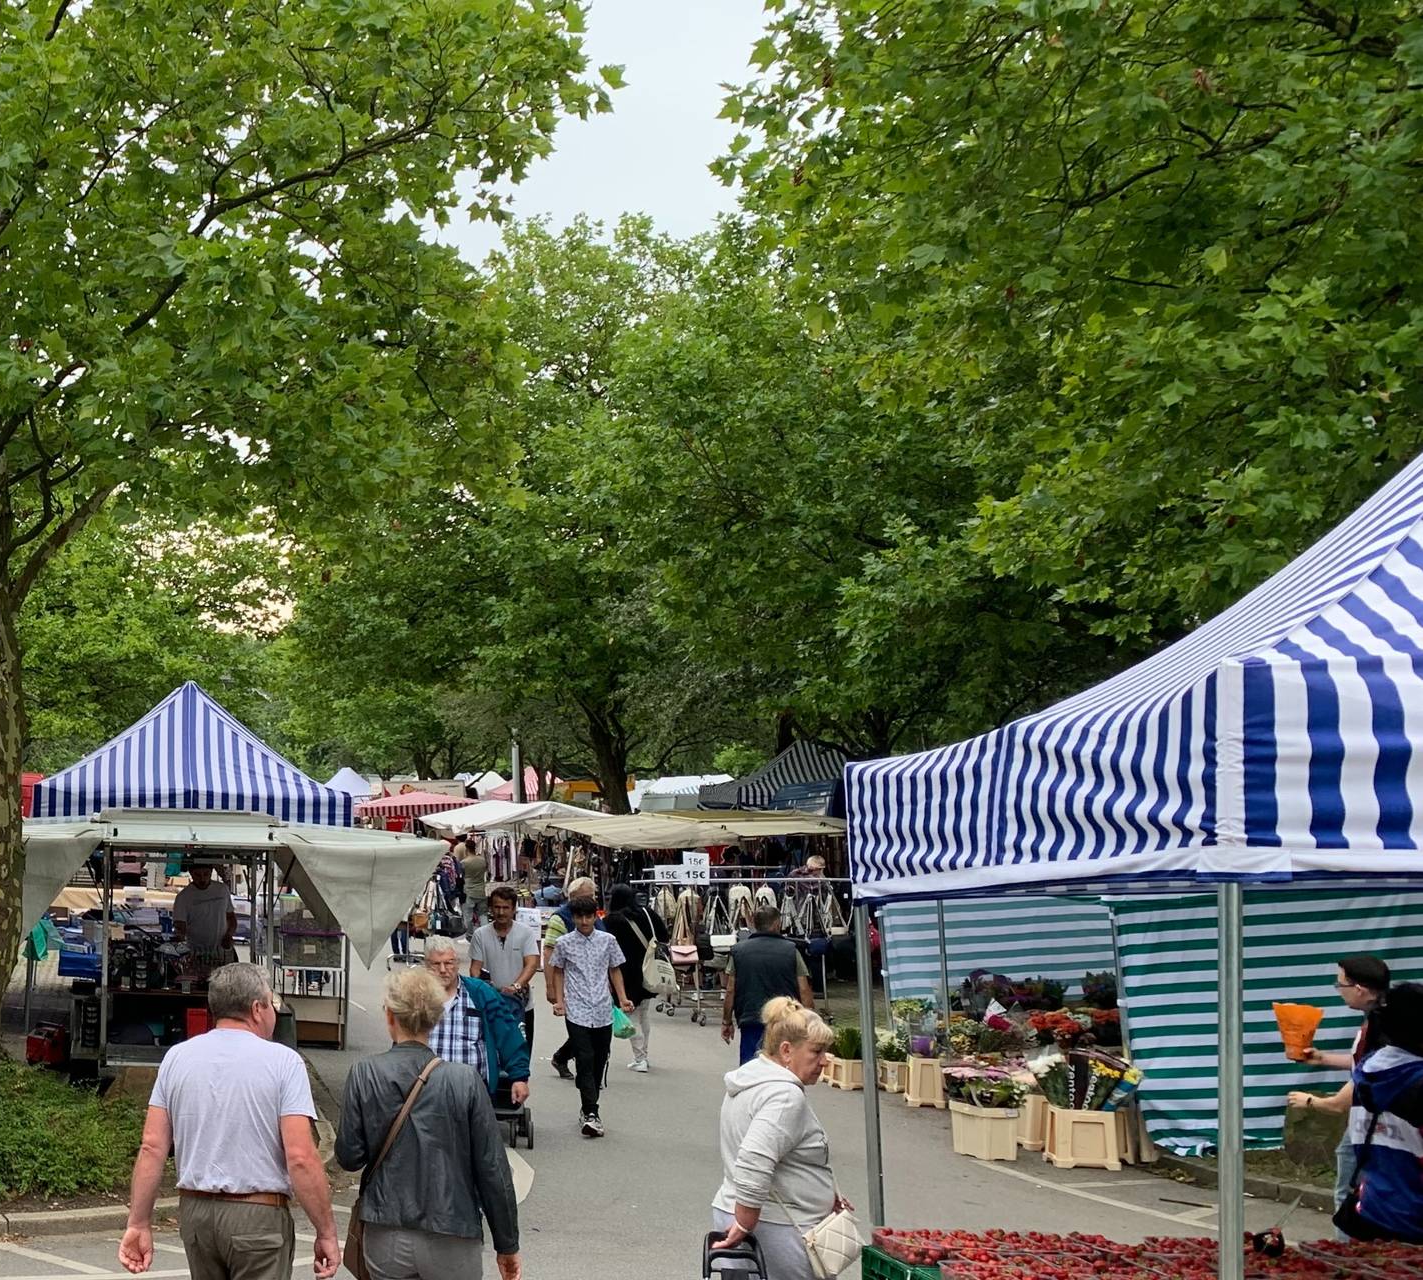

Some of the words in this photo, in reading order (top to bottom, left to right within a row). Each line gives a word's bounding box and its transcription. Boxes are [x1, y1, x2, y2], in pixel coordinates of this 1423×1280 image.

[688, 857, 704, 866] 15€
[660, 870, 678, 880] 15€
[686, 870, 706, 879] 15€
